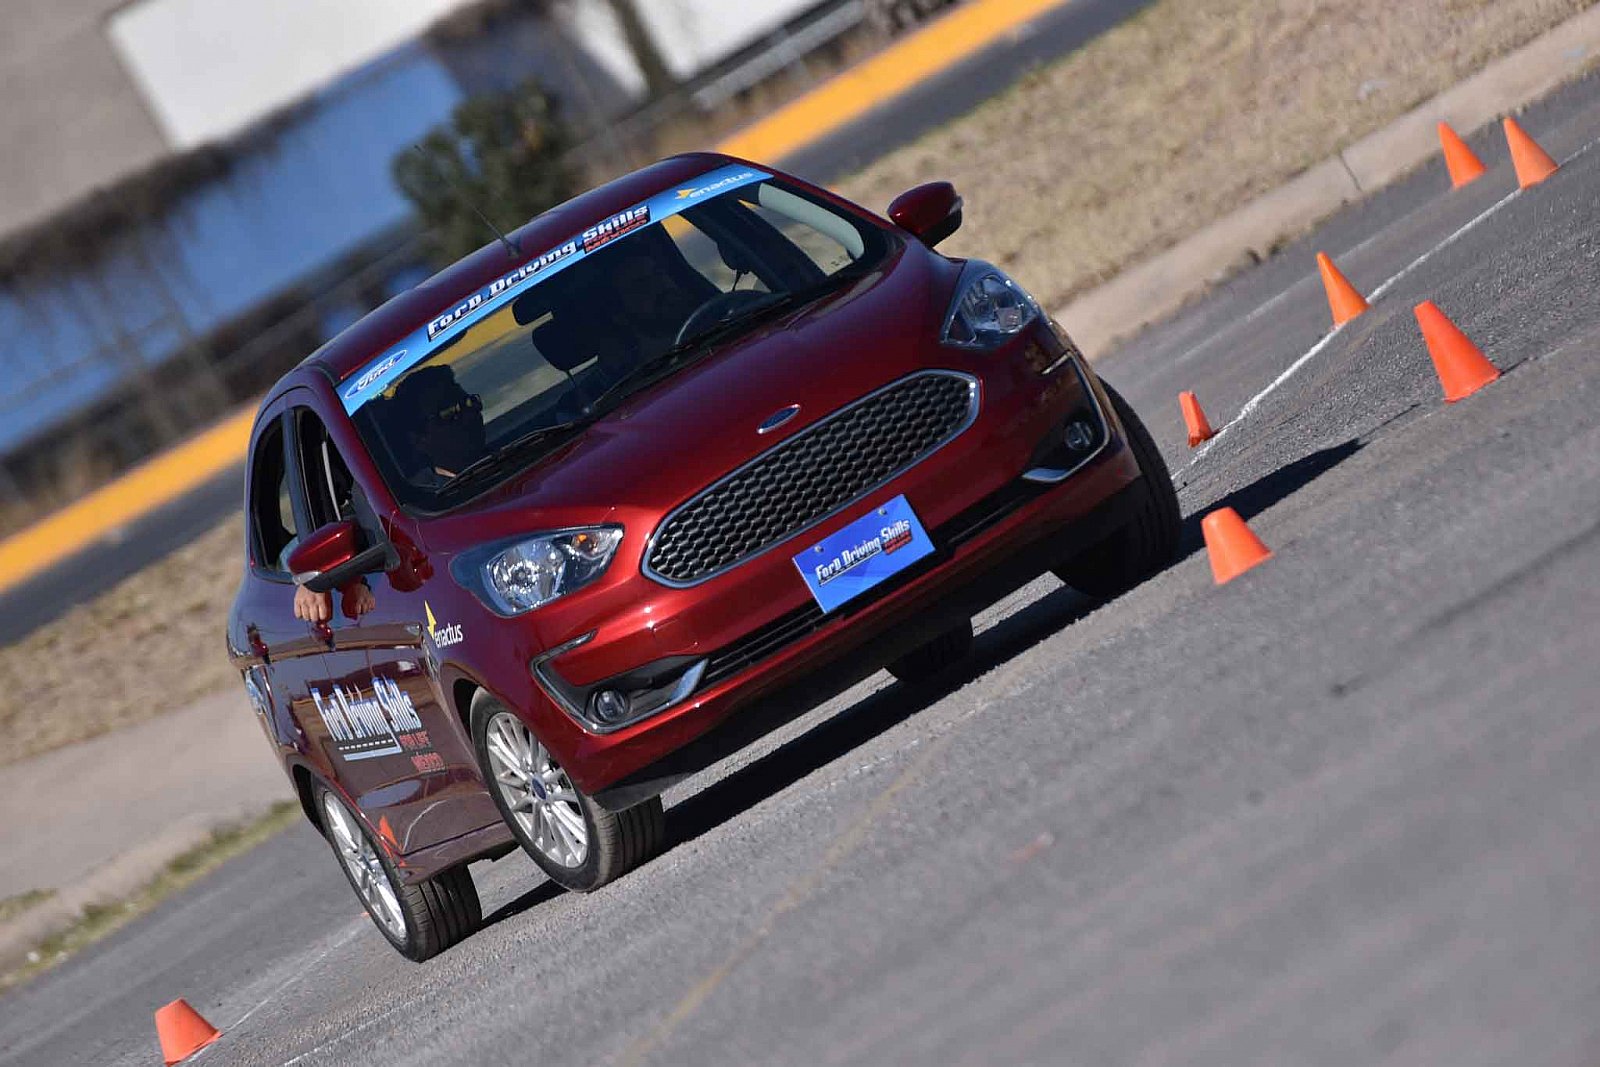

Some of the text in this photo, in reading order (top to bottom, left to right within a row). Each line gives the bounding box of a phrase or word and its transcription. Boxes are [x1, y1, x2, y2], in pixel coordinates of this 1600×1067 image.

[689, 172, 754, 198] enactus
[489, 241, 577, 297] Driving
[582, 205, 648, 244] Skills
[841, 536, 882, 567] Driving
[880, 518, 911, 543] Skills
[434, 621, 464, 649] enactus
[333, 683, 396, 742] Driving
[371, 676, 422, 733] Skills
